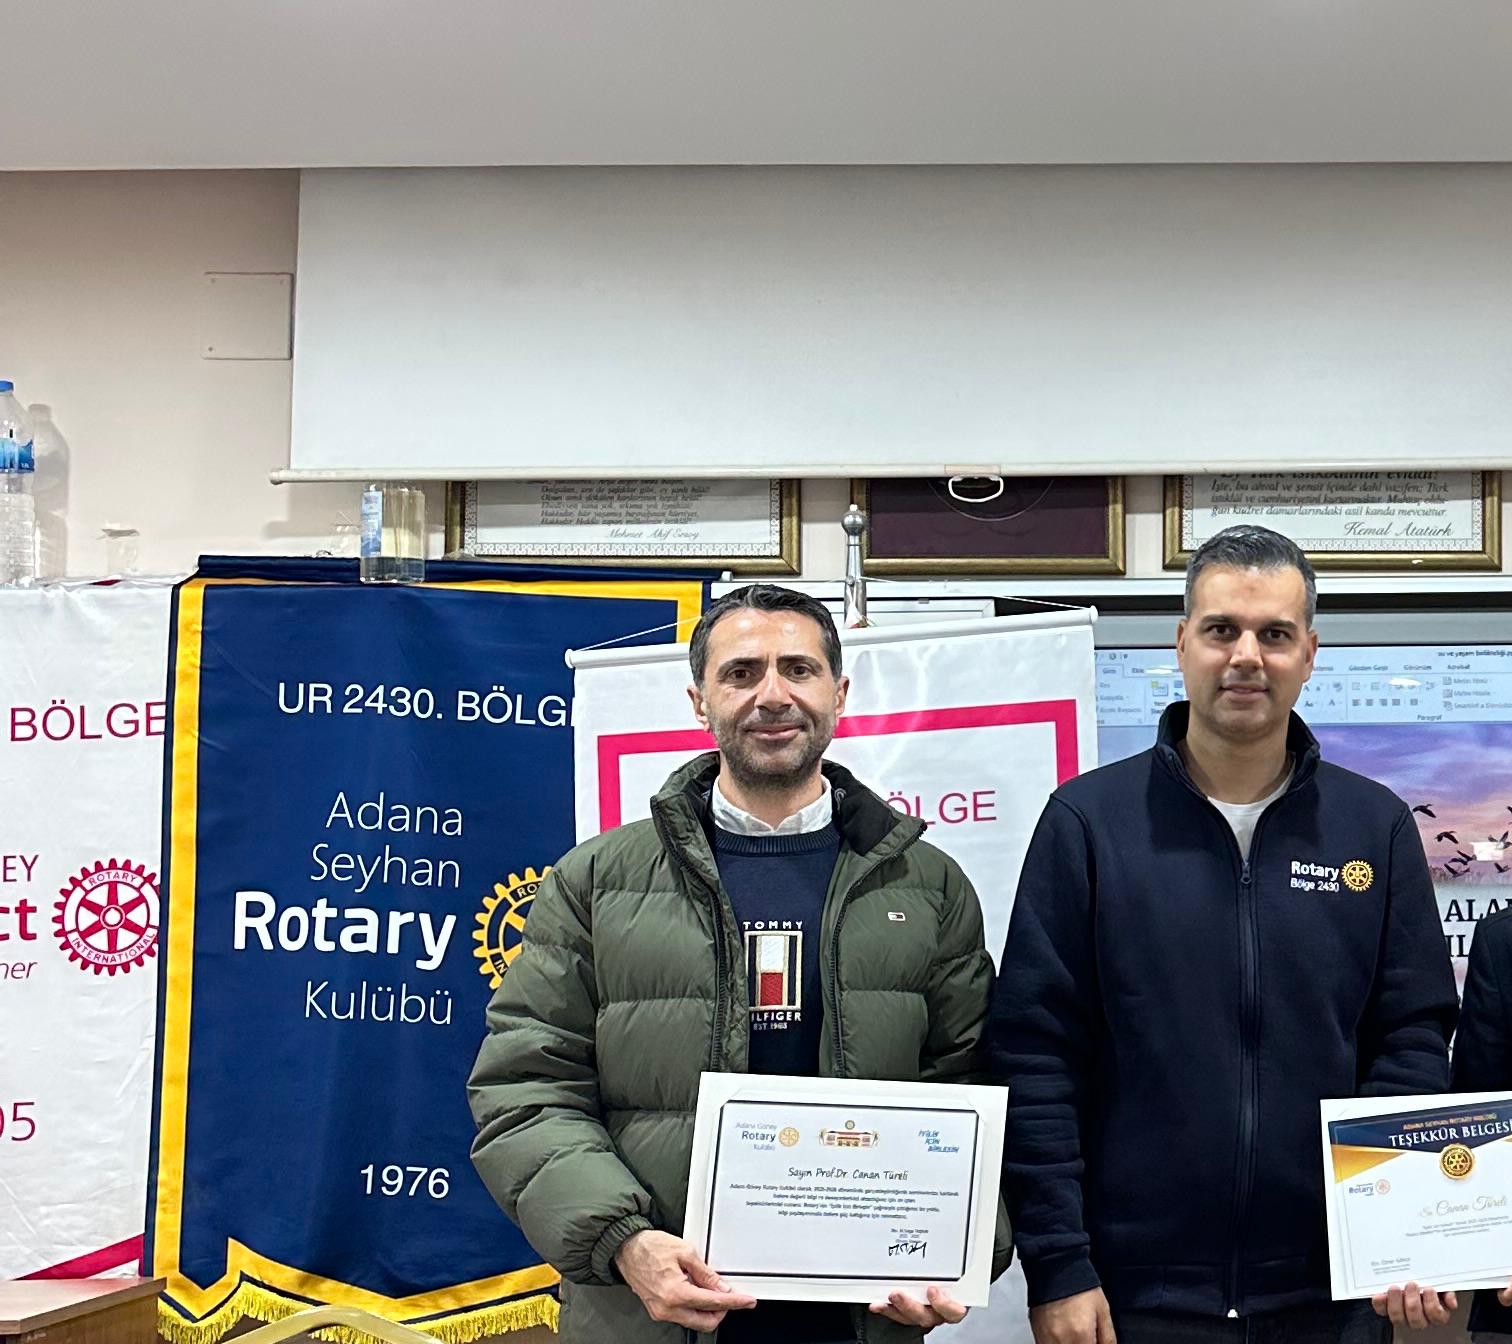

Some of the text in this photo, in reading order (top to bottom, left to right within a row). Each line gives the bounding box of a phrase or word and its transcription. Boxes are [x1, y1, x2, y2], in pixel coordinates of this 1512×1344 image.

[1344, 520, 1453, 536] Kemal Atatürk
[277, 682, 333, 715] UR
[342, 683, 443, 722] 2430.
[10, 699, 166, 742] BÖLGE
[326, 791, 463, 837] Adana
[88, 870, 138, 887] ROTARY
[310, 843, 460, 896] Seyhan
[1291, 860, 1339, 882] Rotary
[1317, 880, 1339, 893] 2430
[233, 891, 457, 971] Rotary
[742, 920, 803, 930] TOMMY
[71, 932, 156, 964] INTERNATIONAL
[304, 980, 453, 1026] Kulübü
[751, 1010, 802, 1022] ILFIGER
[742, 1130, 776, 1142] Rotary
[1389, 1126, 1460, 1148] TEŞEKKÜR
[359, 1164, 450, 1199] 1976
[788, 1166, 812, 1180] Sayın
[852, 1169, 880, 1180] Canan
[1349, 1183, 1374, 1195] Rotary
